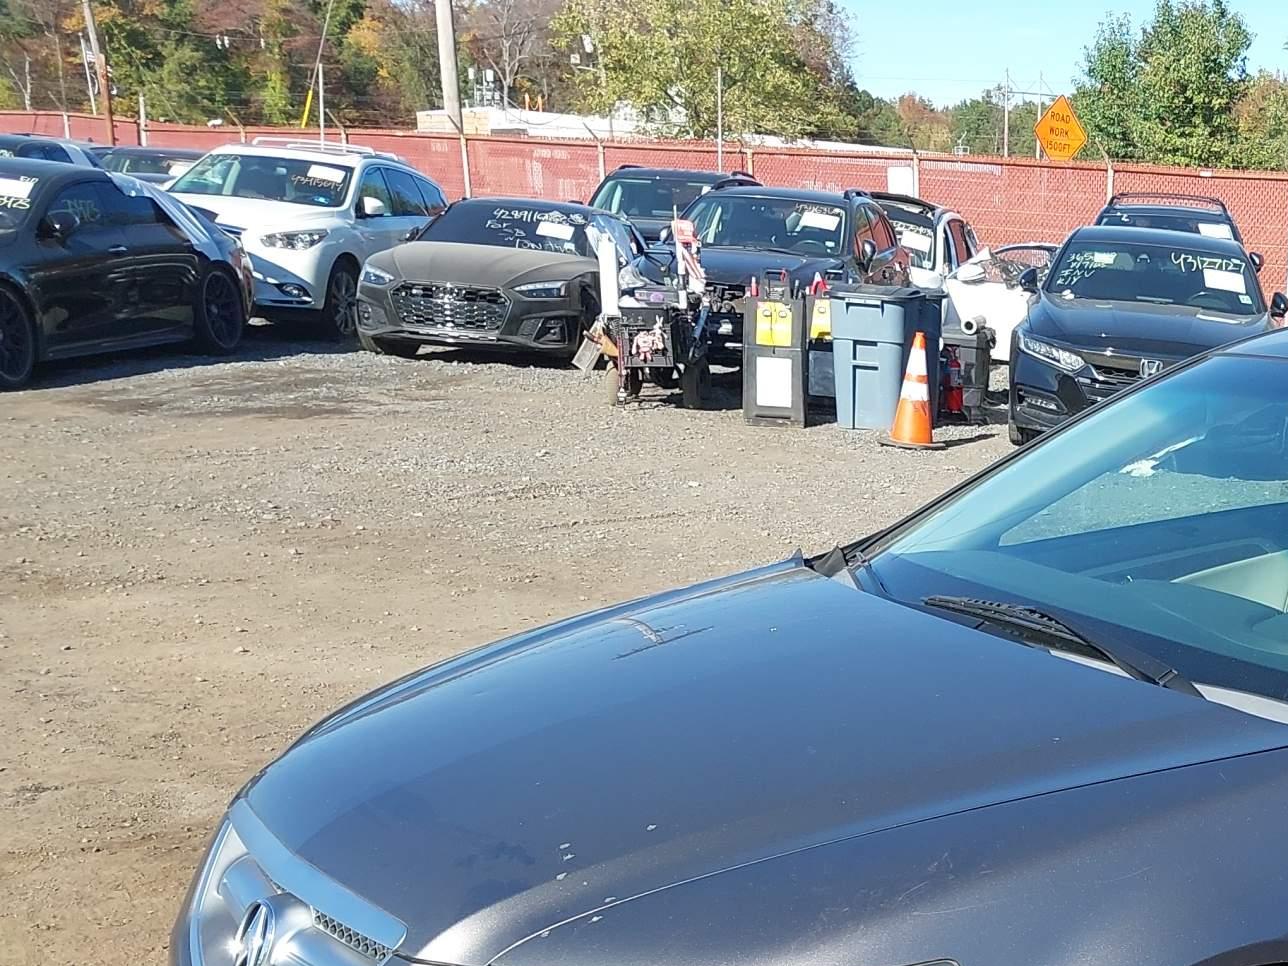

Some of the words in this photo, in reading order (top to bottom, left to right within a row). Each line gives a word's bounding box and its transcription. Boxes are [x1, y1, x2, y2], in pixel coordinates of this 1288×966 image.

[1050, 111, 1071, 124] ROAD
[1049, 127, 1069, 138] WORK
[1046, 140, 1071, 153] 1500FT
